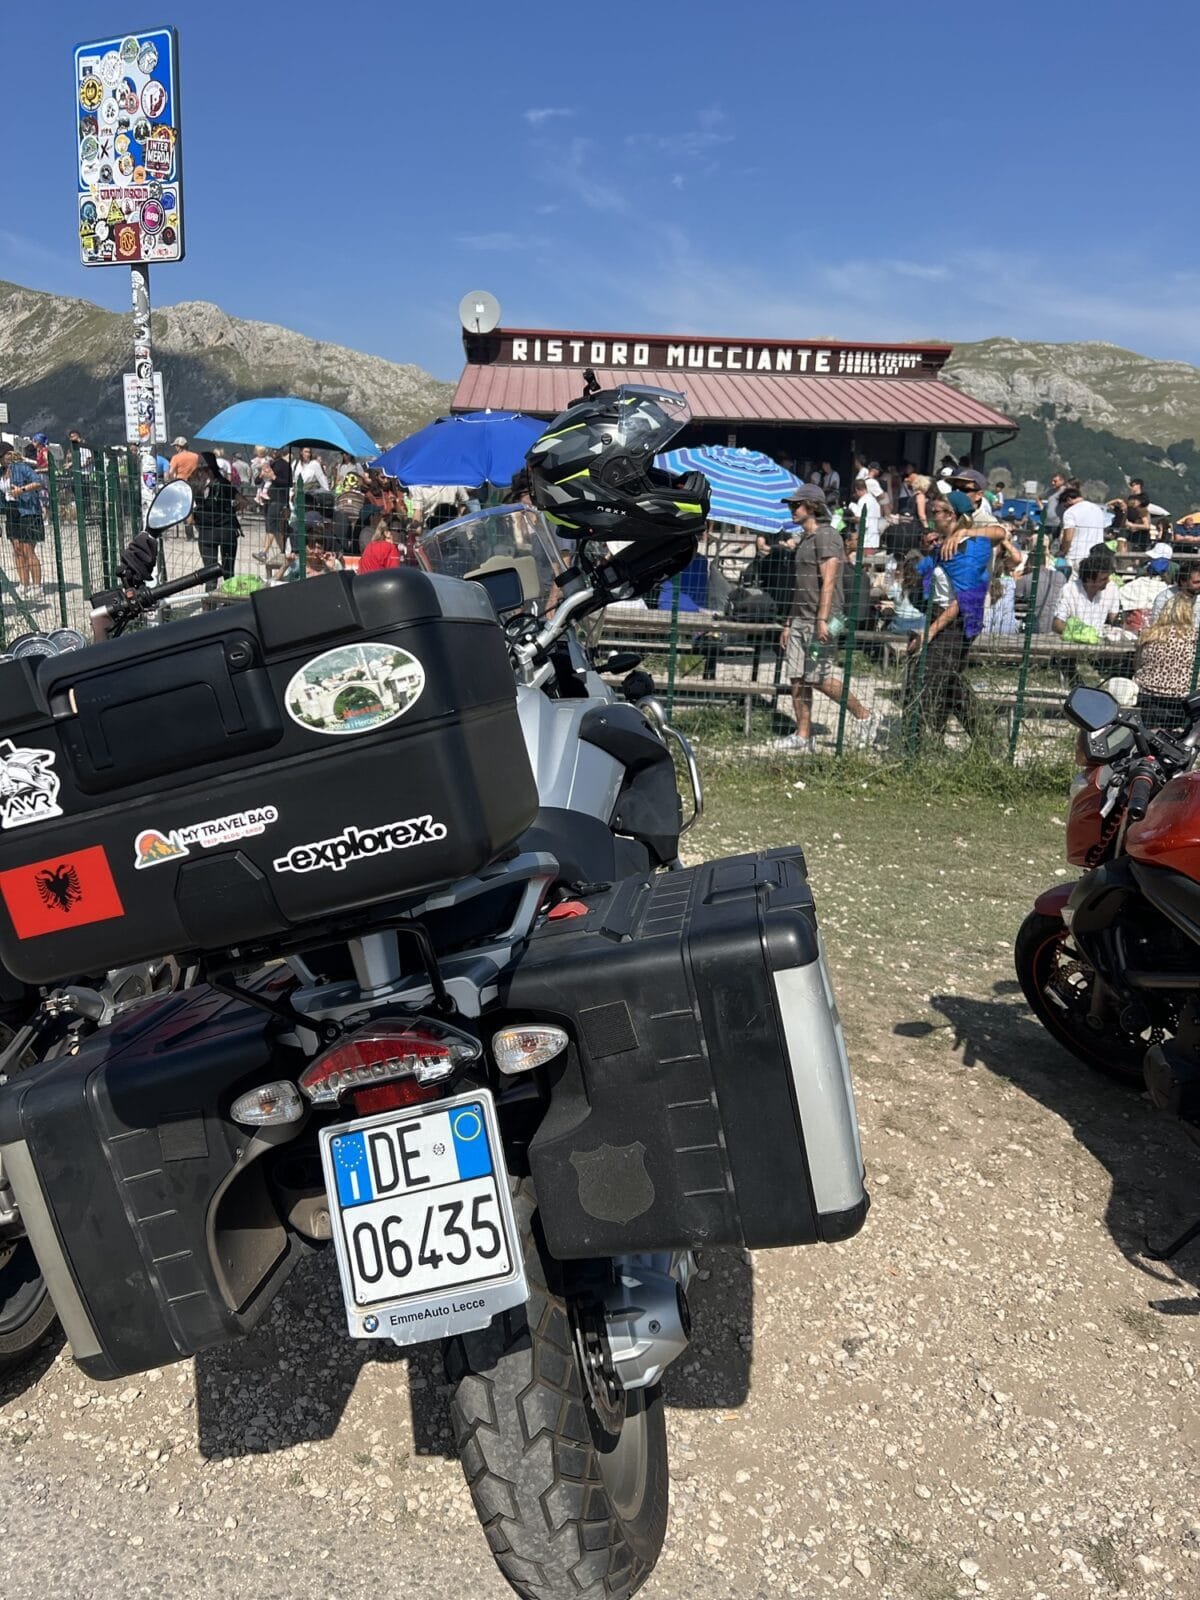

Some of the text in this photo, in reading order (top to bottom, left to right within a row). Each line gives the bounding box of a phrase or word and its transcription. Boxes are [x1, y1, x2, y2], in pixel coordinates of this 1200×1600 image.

[147, 150, 170, 164] MERDA
[150, 140, 168, 151] INTER
[512, 338, 832, 373] RISTORO MUCCIANTE
[838, 357, 916, 368] ARROSTICINI
[838, 365, 899, 375] FORMAGGI
[8, 793, 52, 818] AWR
[182, 809, 275, 842] MY TRAVEL BAG
[368, 1122, 430, 1194] DE
[353, 1193, 501, 1284] 06435
[390, 1298, 486, 1326] EmmeAuto Lecce
